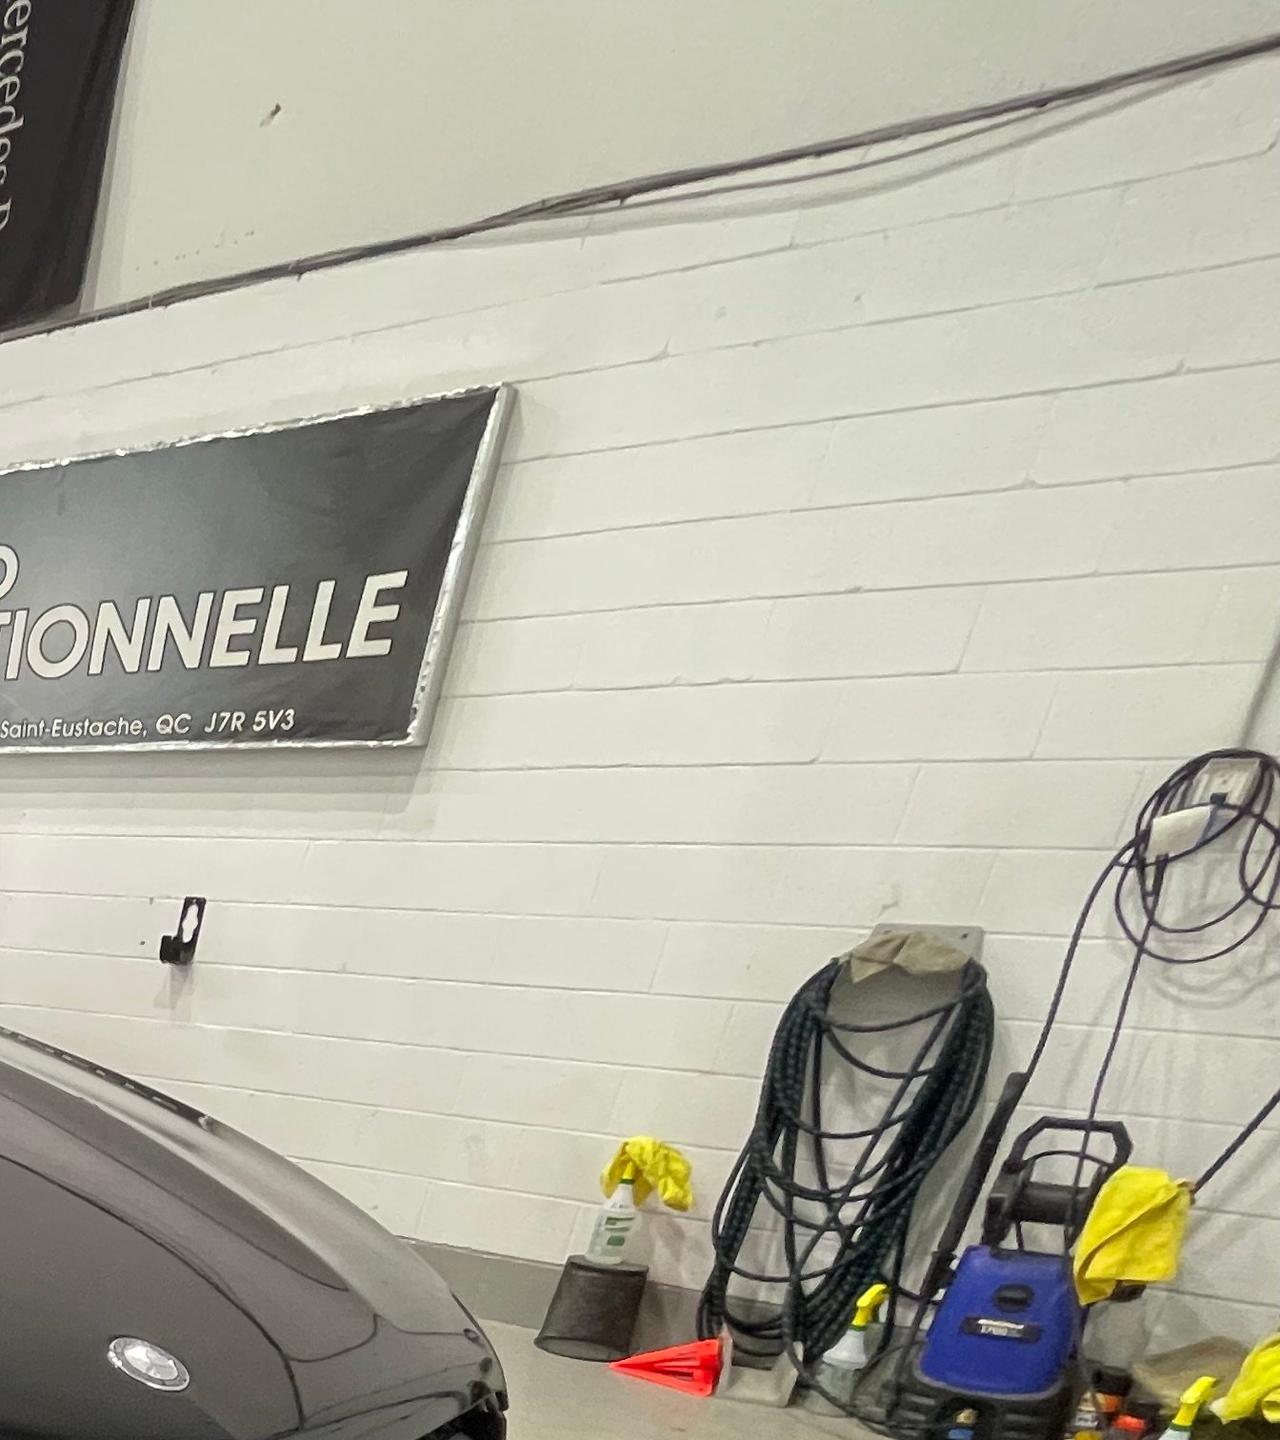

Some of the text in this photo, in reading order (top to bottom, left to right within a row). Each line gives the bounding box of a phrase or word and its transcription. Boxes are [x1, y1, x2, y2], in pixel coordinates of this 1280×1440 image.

[0, 717, 147, 738] Saint-Eustache,
[155, 713, 191, 735] QC
[204, 710, 247, 733] J7R
[252, 708, 295, 732] 5V3
